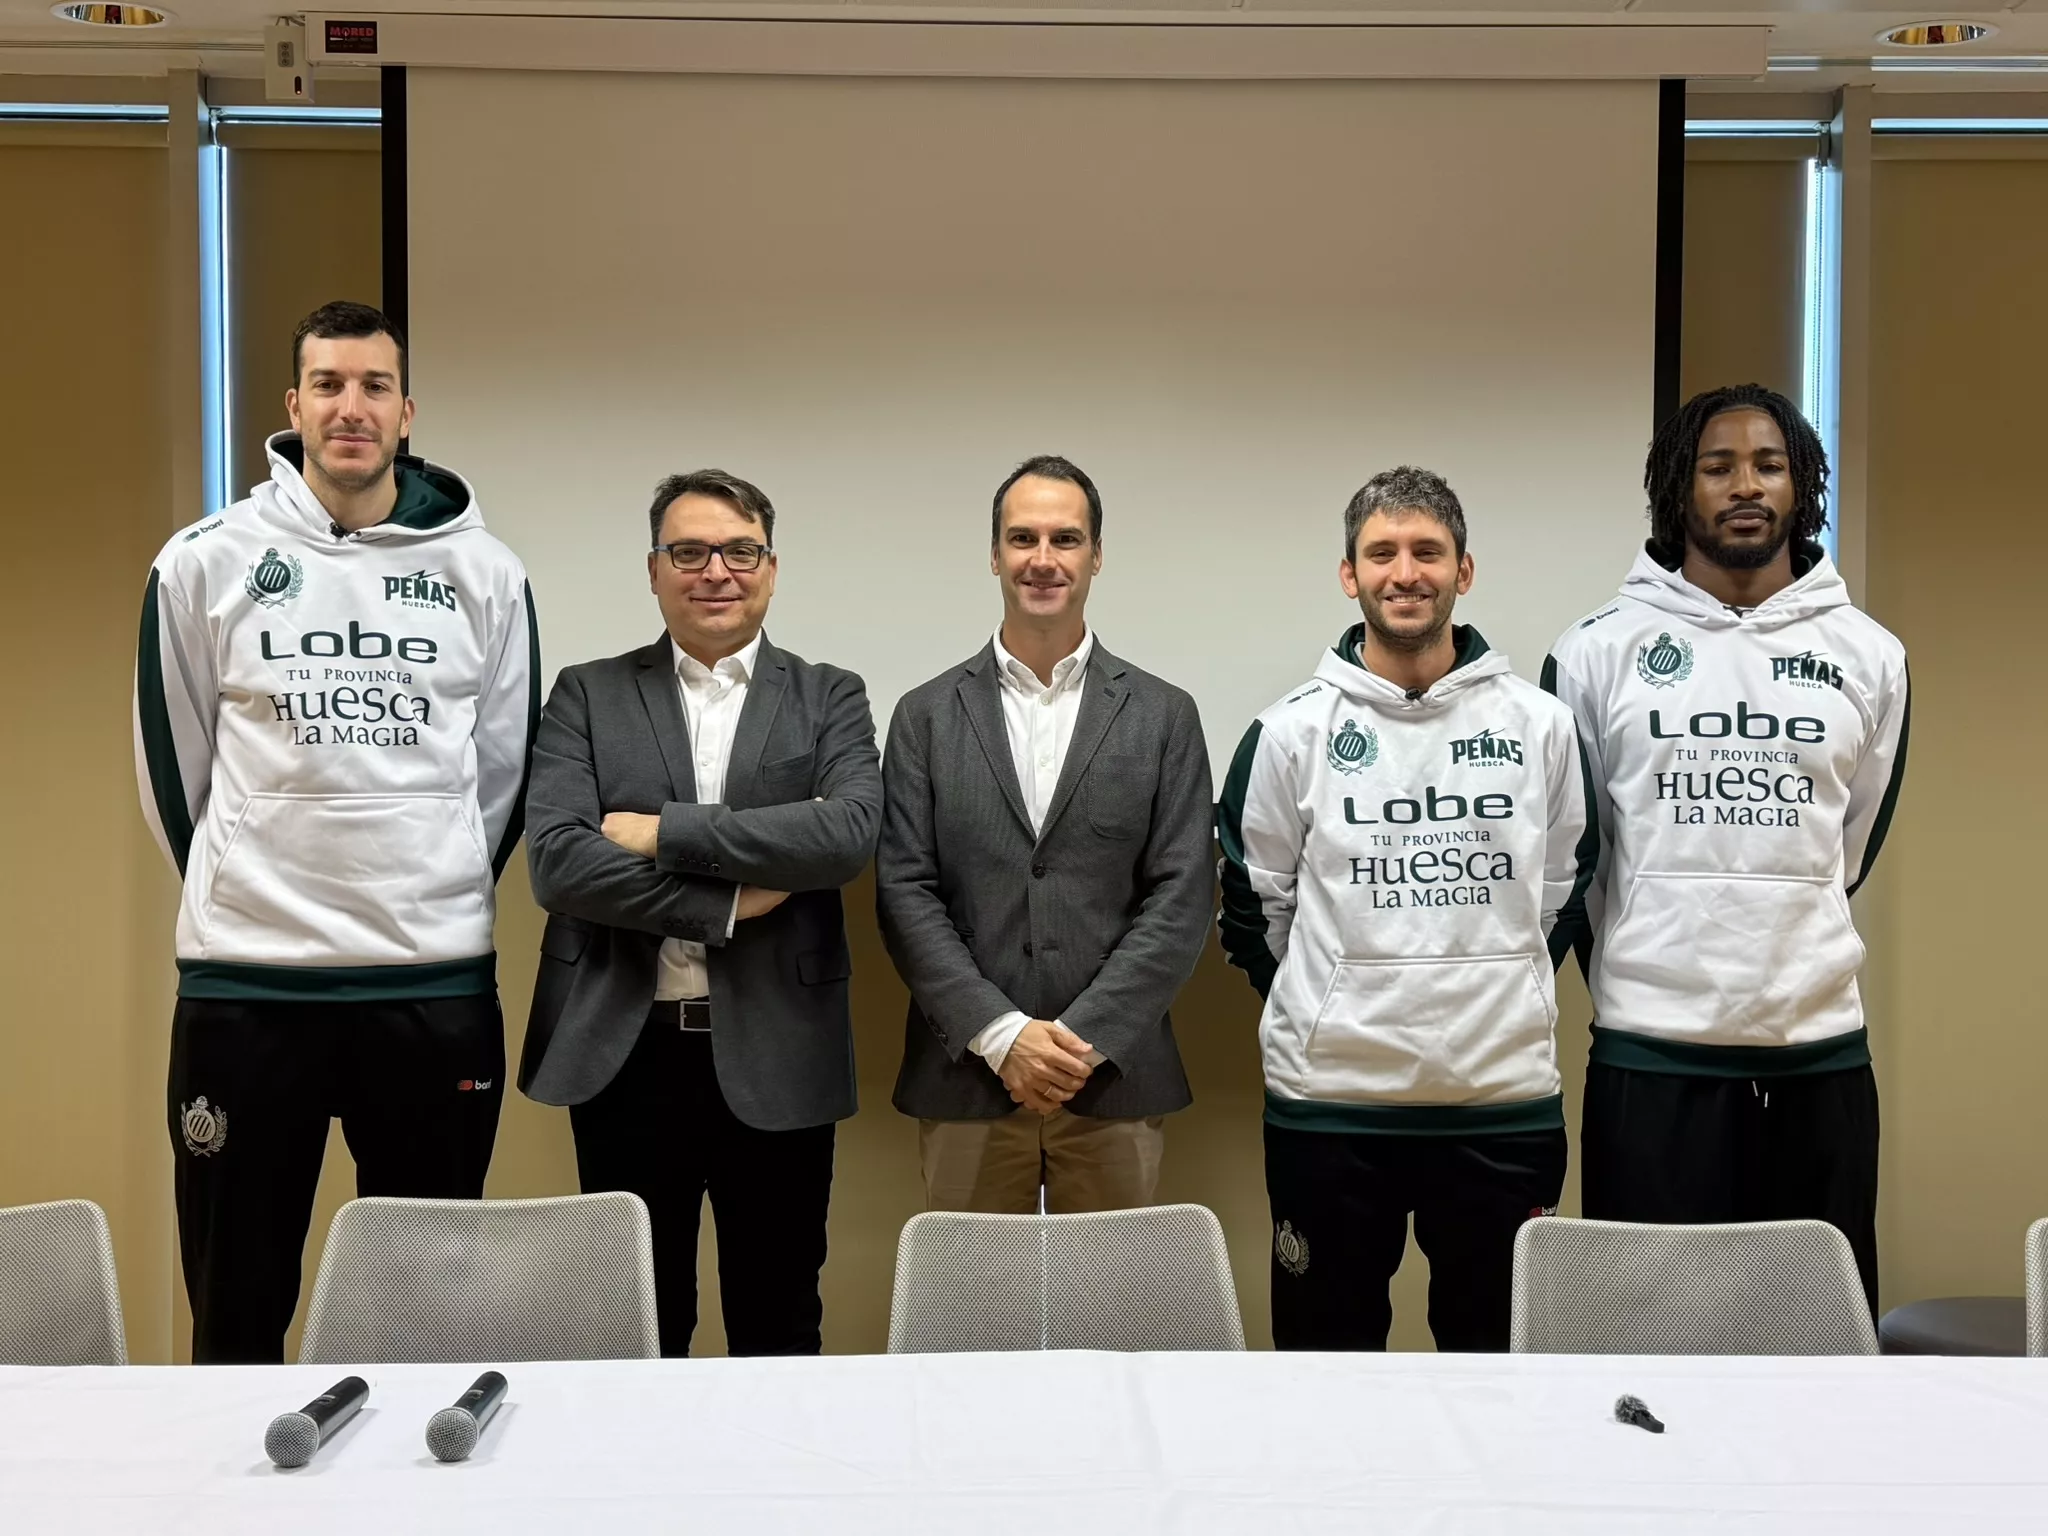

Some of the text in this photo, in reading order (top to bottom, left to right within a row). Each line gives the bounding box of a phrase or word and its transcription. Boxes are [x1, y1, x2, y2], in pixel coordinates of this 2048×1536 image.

[329, 26, 375, 37] MORED
[382, 569, 457, 612] PEÑAS
[402, 599, 438, 610] HUESCA
[260, 620, 438, 664] Lobe
[1769, 650, 1844, 691] PEÑAS
[1789, 680, 1824, 690] HUESCA
[267, 686, 431, 726] Huesca
[1649, 701, 1826, 744] Lobe
[1448, 728, 1524, 767] PEÑAS
[1469, 760, 1504, 768] HUESCA
[1343, 785, 1514, 825] Lobe
[1653, 766, 1816, 805] Huesca
[1349, 847, 1516, 885] Huesca
